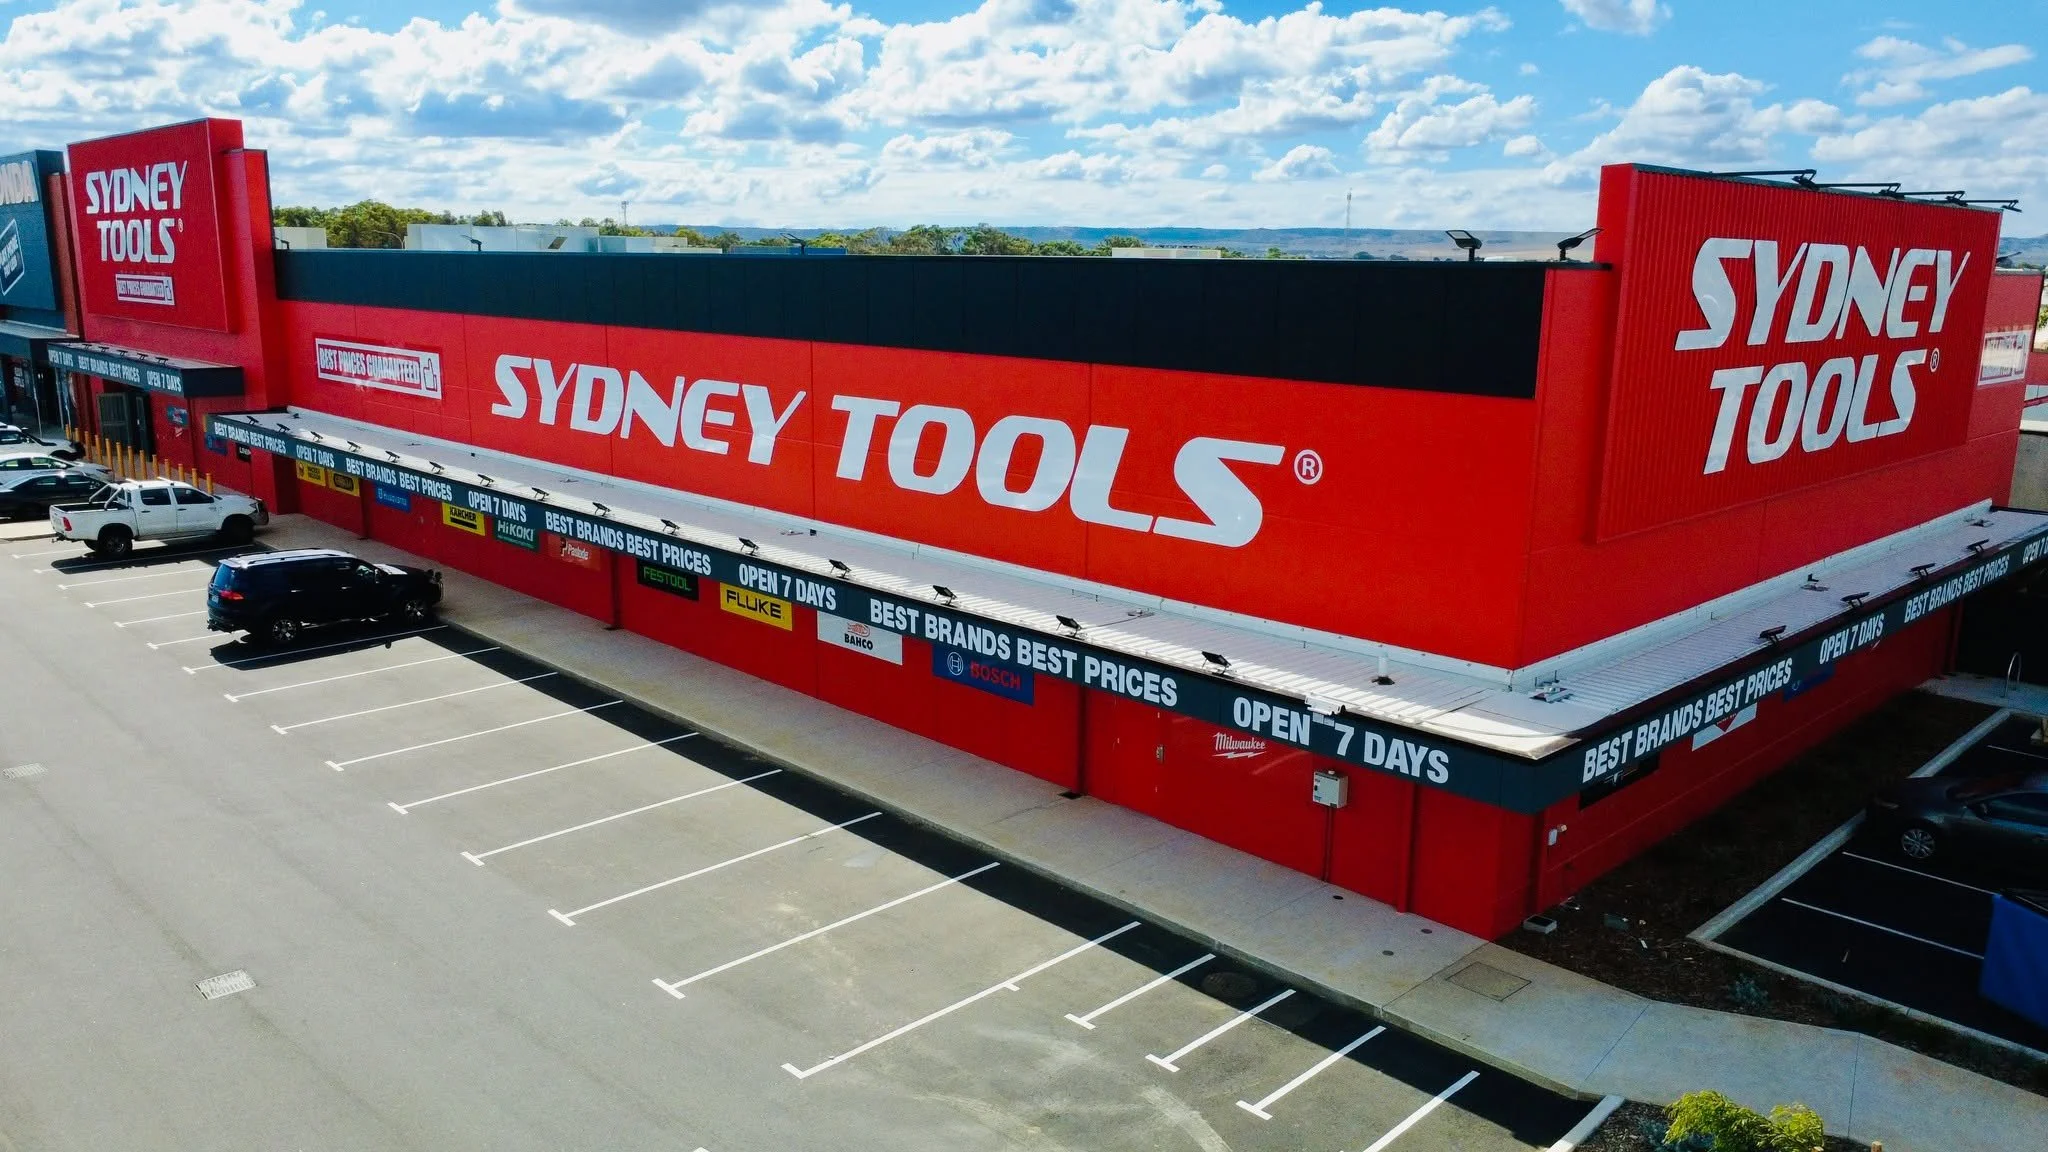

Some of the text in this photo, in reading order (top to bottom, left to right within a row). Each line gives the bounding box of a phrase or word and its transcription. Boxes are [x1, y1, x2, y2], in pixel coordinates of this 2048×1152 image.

[86, 160, 187, 214] SYDNEY
[97, 218, 175, 264] TOOLS
[1674, 237, 1970, 351] SYDNEY
[146, 370, 161, 387] OPEN
[160, 373, 165, 389] 7
[165, 374, 182, 393] DAYS
[319, 347, 420, 385] BEST PRICES GUARANTEED
[1703, 349, 1927, 475] TOOLS
[491, 354, 806, 466] SYDNEY
[831, 394, 1285, 548] TOOLS
[497, 519, 534, 542] HiKOKI
[643, 566, 692, 592] FESTOOL
[213, 421, 228, 438] BEST
[227, 425, 250, 444] BRANDS
[249, 431, 265, 449] BEST
[264, 435, 287, 454] PRICES
[296, 444, 312, 463] OPEN
[312, 448, 317, 463] 7
[318, 449, 335, 469] DAYS
[346, 457, 365, 476] BEST
[366, 462, 397, 486] BRANDS
[399, 471, 422, 493] BEST
[421, 478, 453, 501] PRICES
[468, 490, 492, 514] OPEN
[493, 497, 500, 515] 7
[502, 499, 527, 523] DAYS
[545, 511, 575, 537] BEST
[576, 520, 625, 551] BRANDS
[626, 536, 661, 561] BEST
[662, 542, 712, 576] PRICES
[738, 563, 778, 597] OPEN
[781, 575, 791, 598] 7
[795, 579, 837, 611] DAYS
[870, 598, 920, 632] BEST
[924, 612, 1011, 661] BRANDS
[1016, 637, 1078, 679] BEST
[1084, 654, 1178, 707] PRICES
[1233, 696, 1310, 746] OPEN
[1333, 722, 1355, 757] 7
[1363, 730, 1450, 785] DAYS
[726, 590, 782, 619] FLUKE
[844, 632, 874, 651] BAHCO
[970, 660, 1022, 691] BOSCH
[1582, 730, 1634, 784] BEST
[1634, 698, 1703, 759] BRANDS
[1704, 679, 1745, 722] BEST
[1745, 657, 1793, 704] PRICES
[1819, 628, 1849, 665] OPEN
[1849, 624, 1858, 651] 7
[1858, 613, 1885, 647] DAYS
[1904, 591, 1930, 623] BEST
[1928, 575, 1964, 612] BRANDS
[1962, 565, 1984, 595] BEST
[1983, 554, 2010, 585] PRICES
[2022, 540, 2041, 565] OPEN
[1212, 732, 1266, 751] Milwaukee
